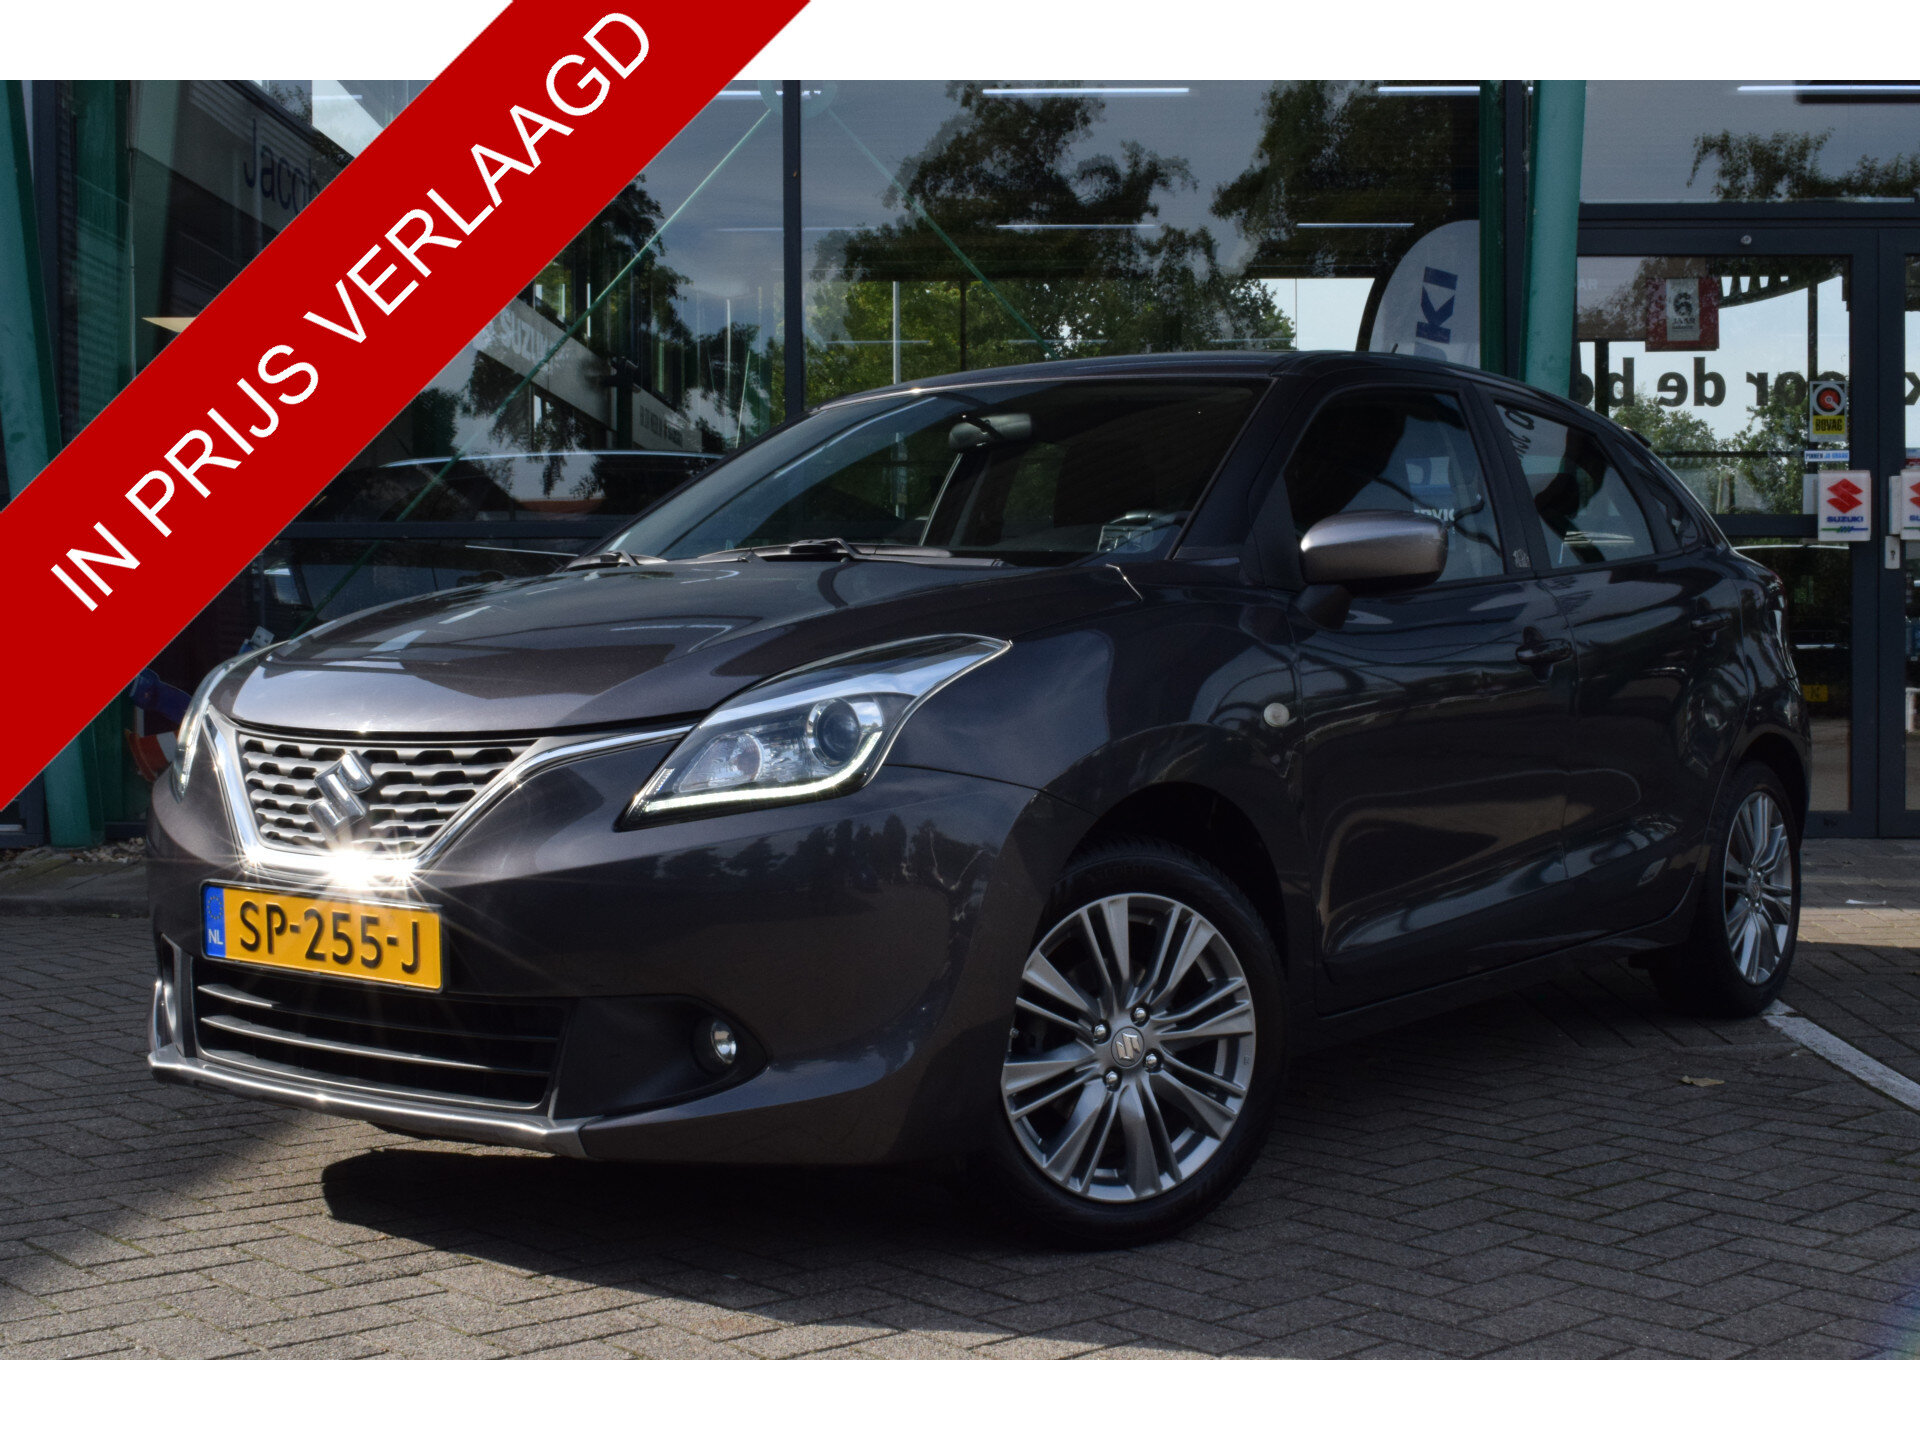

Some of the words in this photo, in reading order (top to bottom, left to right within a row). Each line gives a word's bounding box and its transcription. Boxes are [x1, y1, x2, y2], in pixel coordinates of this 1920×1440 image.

[1815, 418, 1843, 432] BOVAG
[1826, 515, 1864, 523] SUZUKI
[208, 928, 224, 946] NL
[239, 900, 420, 975] SP-255-J
